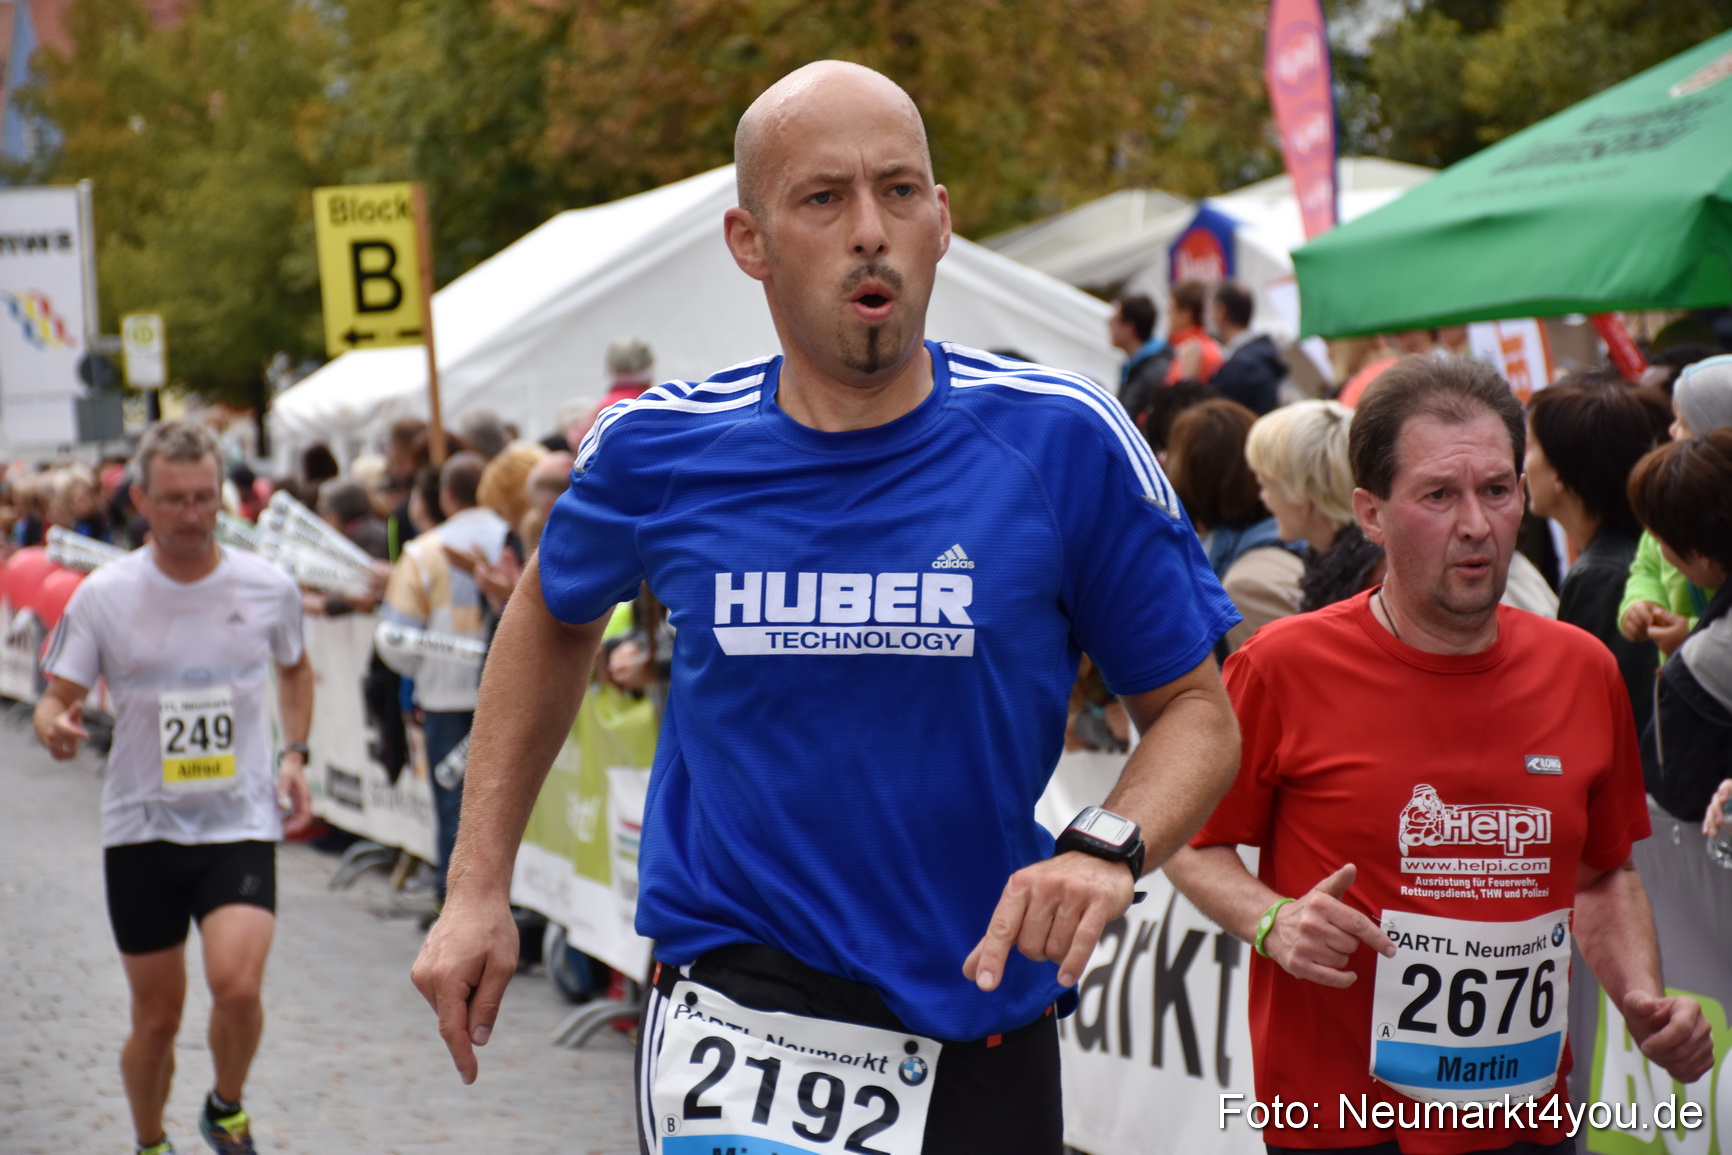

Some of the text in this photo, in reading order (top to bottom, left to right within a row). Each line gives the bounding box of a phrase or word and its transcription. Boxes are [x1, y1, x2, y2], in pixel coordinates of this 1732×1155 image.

[329, 193, 412, 226] Block
[350, 241, 403, 313] B
[931, 558, 975, 569] adidas
[714, 571, 975, 626] HUBER
[765, 631, 963, 650] TECHNOLOGY
[165, 713, 232, 753] 249
[1442, 809, 1547, 853] Helpi
[1404, 859, 1548, 874] www.helpi.com
[1400, 886, 1549, 900] Rettungsdienst, THW und Polizei
[1415, 876, 1539, 889] Ausrüstung für Feuerwehr,
[1387, 931, 1548, 958] PARTL Neumarkt
[1058, 886, 1240, 1089] arkt
[1397, 959, 1556, 1037] 2676
[1381, 1025, 1390, 1038] A
[1436, 1055, 1519, 1083] Martin
[683, 1036, 900, 1155] 2192
[667, 1117, 675, 1132] B
